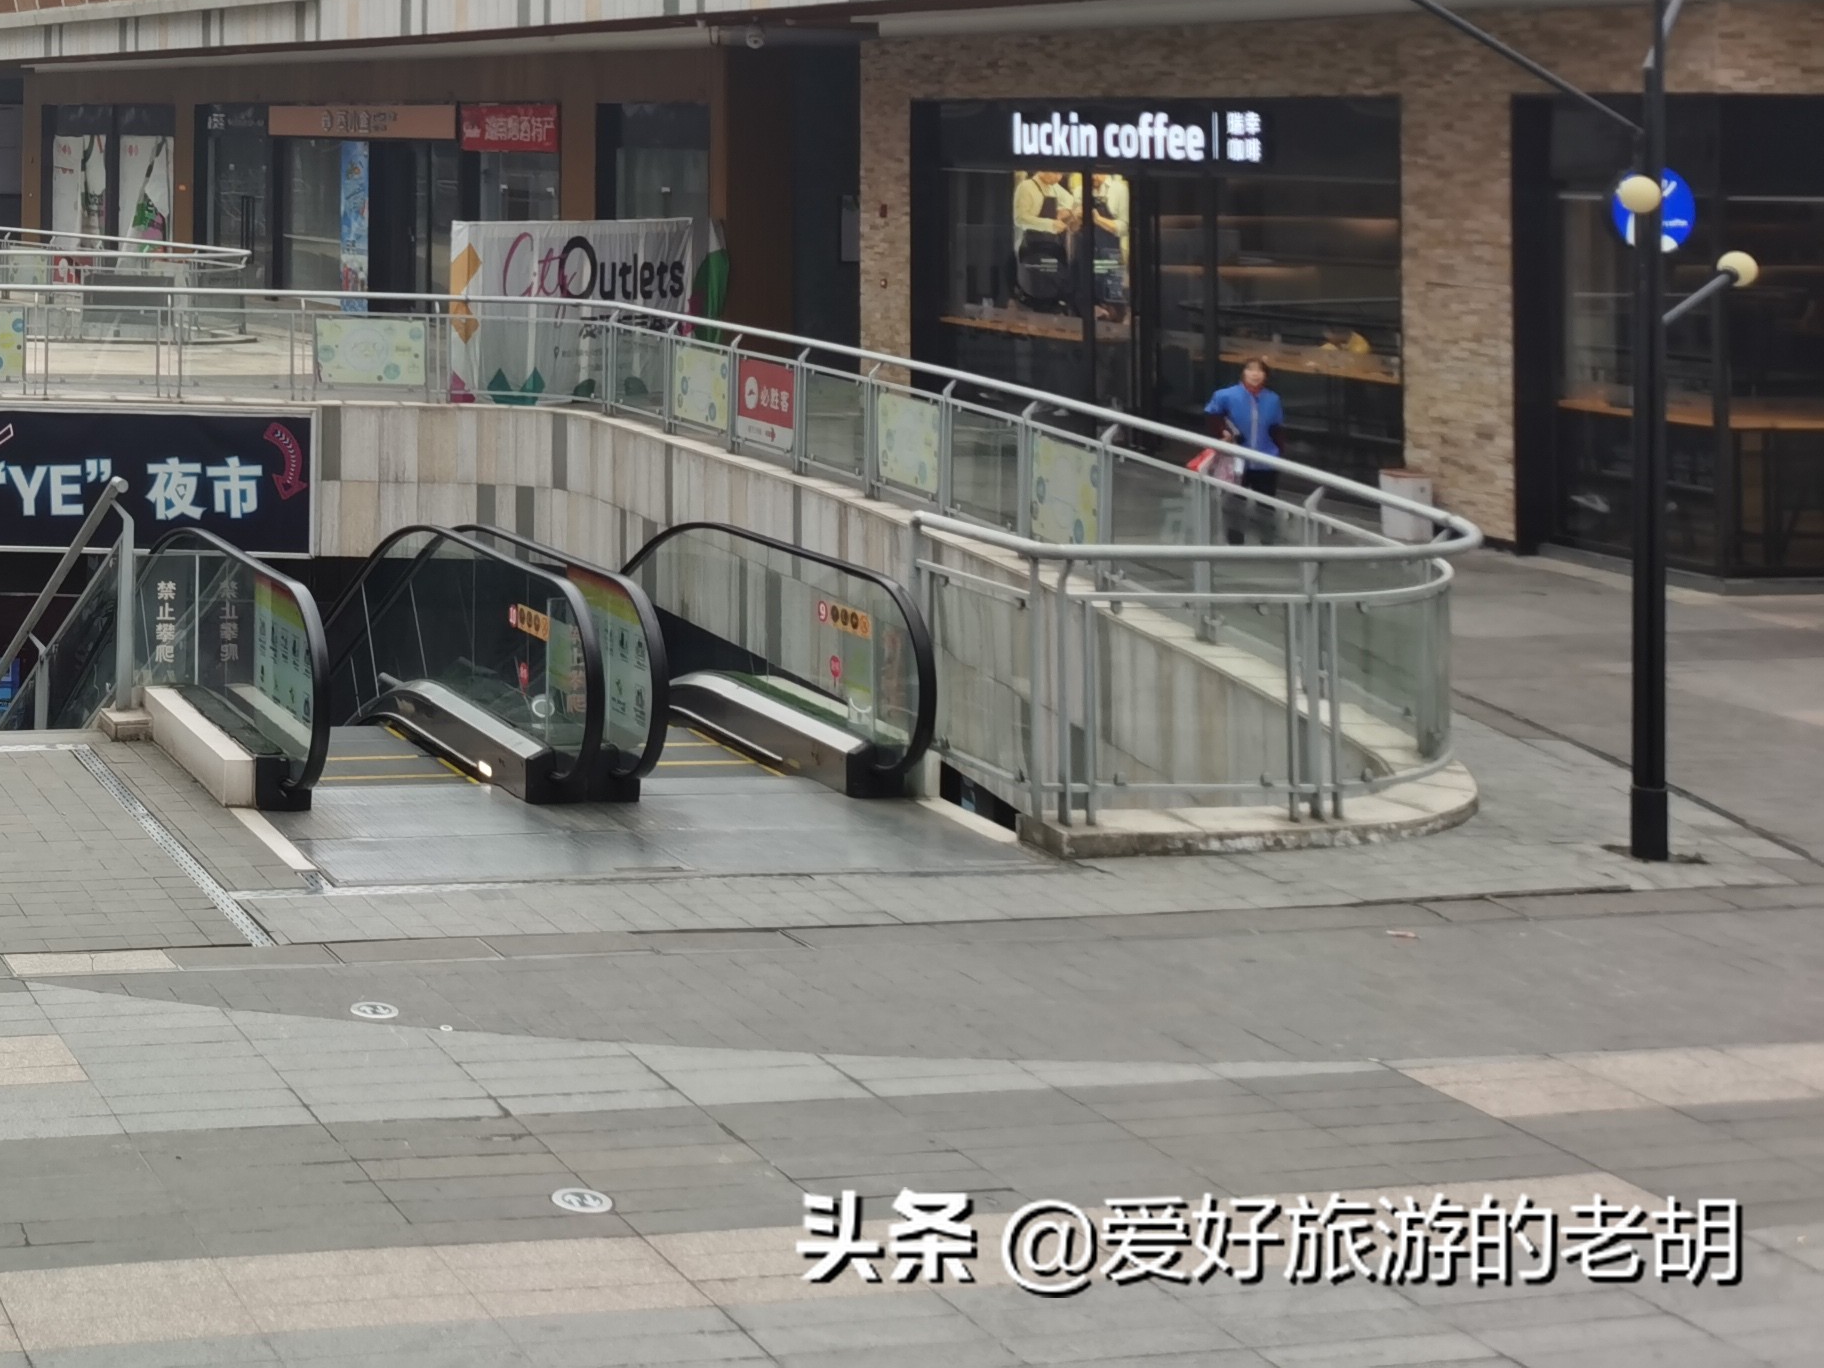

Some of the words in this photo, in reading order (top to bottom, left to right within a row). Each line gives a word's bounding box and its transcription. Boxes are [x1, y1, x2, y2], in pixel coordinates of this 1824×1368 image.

[1012, 111, 1098, 158] luckin
[1103, 112, 1205, 162] coffee
[1226, 111, 1262, 136] 瑞幸
[1226, 137, 1263, 163] 咖啡
[559, 236, 685, 300] Outlets
[145, 456, 264, 521] 夜市
[155, 580, 177, 664] 禁止攀爬
